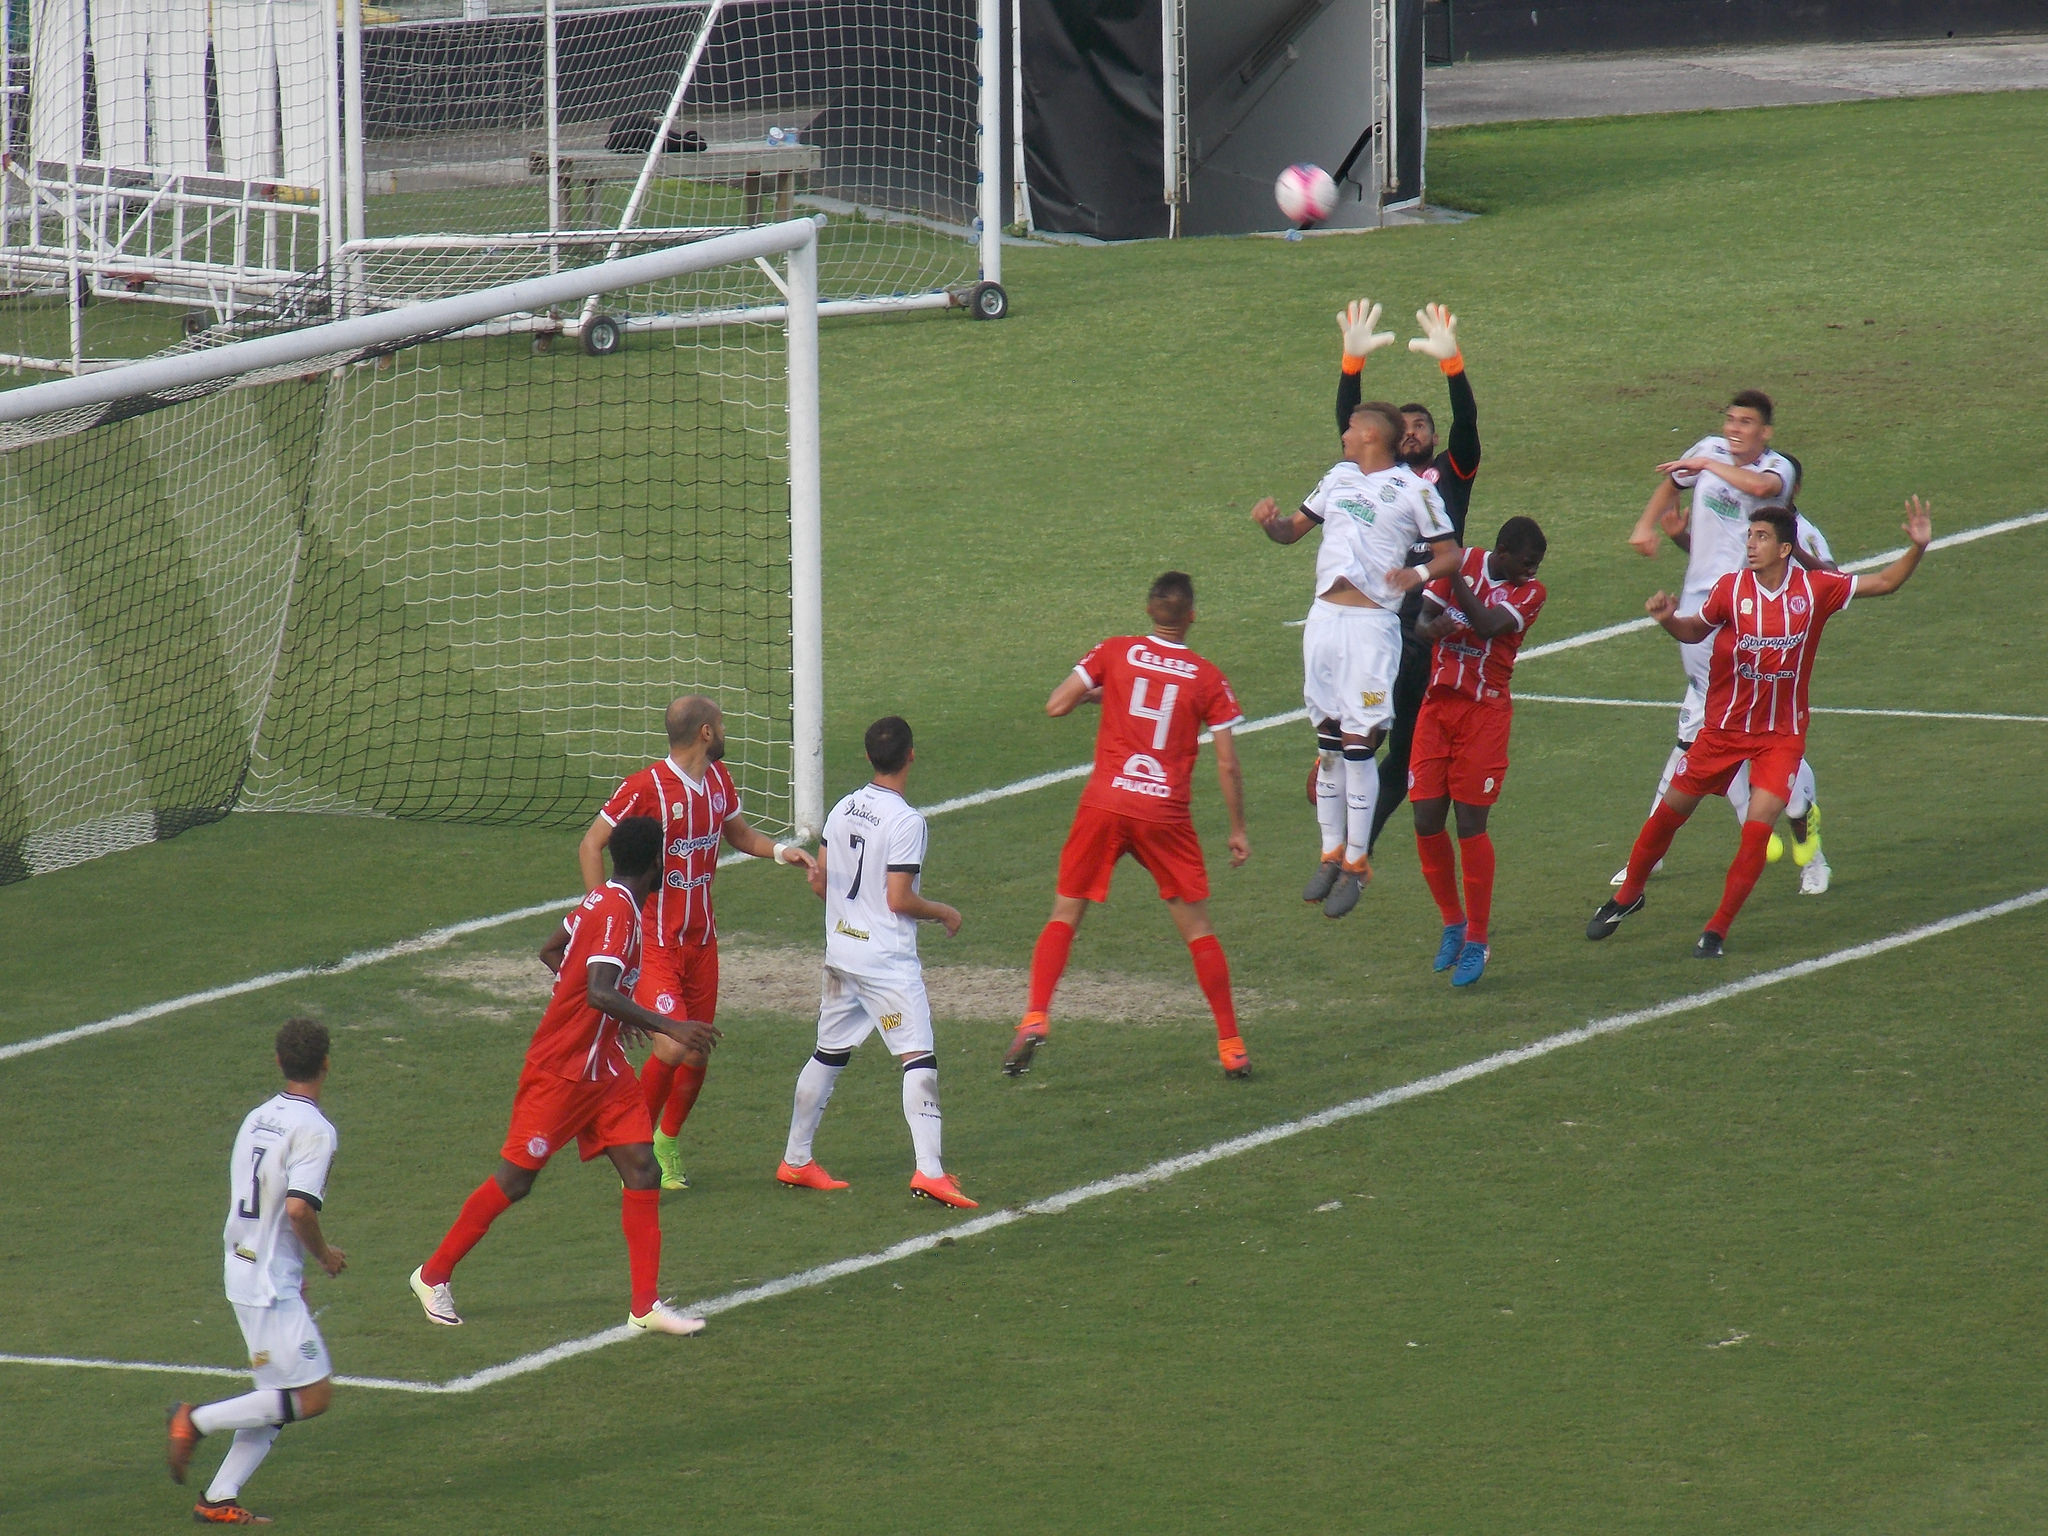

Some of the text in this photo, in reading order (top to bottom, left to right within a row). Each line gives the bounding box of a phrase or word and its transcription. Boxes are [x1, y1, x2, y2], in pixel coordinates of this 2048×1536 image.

[1129, 676, 1179, 750] 4
[846, 833, 866, 900] 7
[239, 1146, 266, 1219] 3
